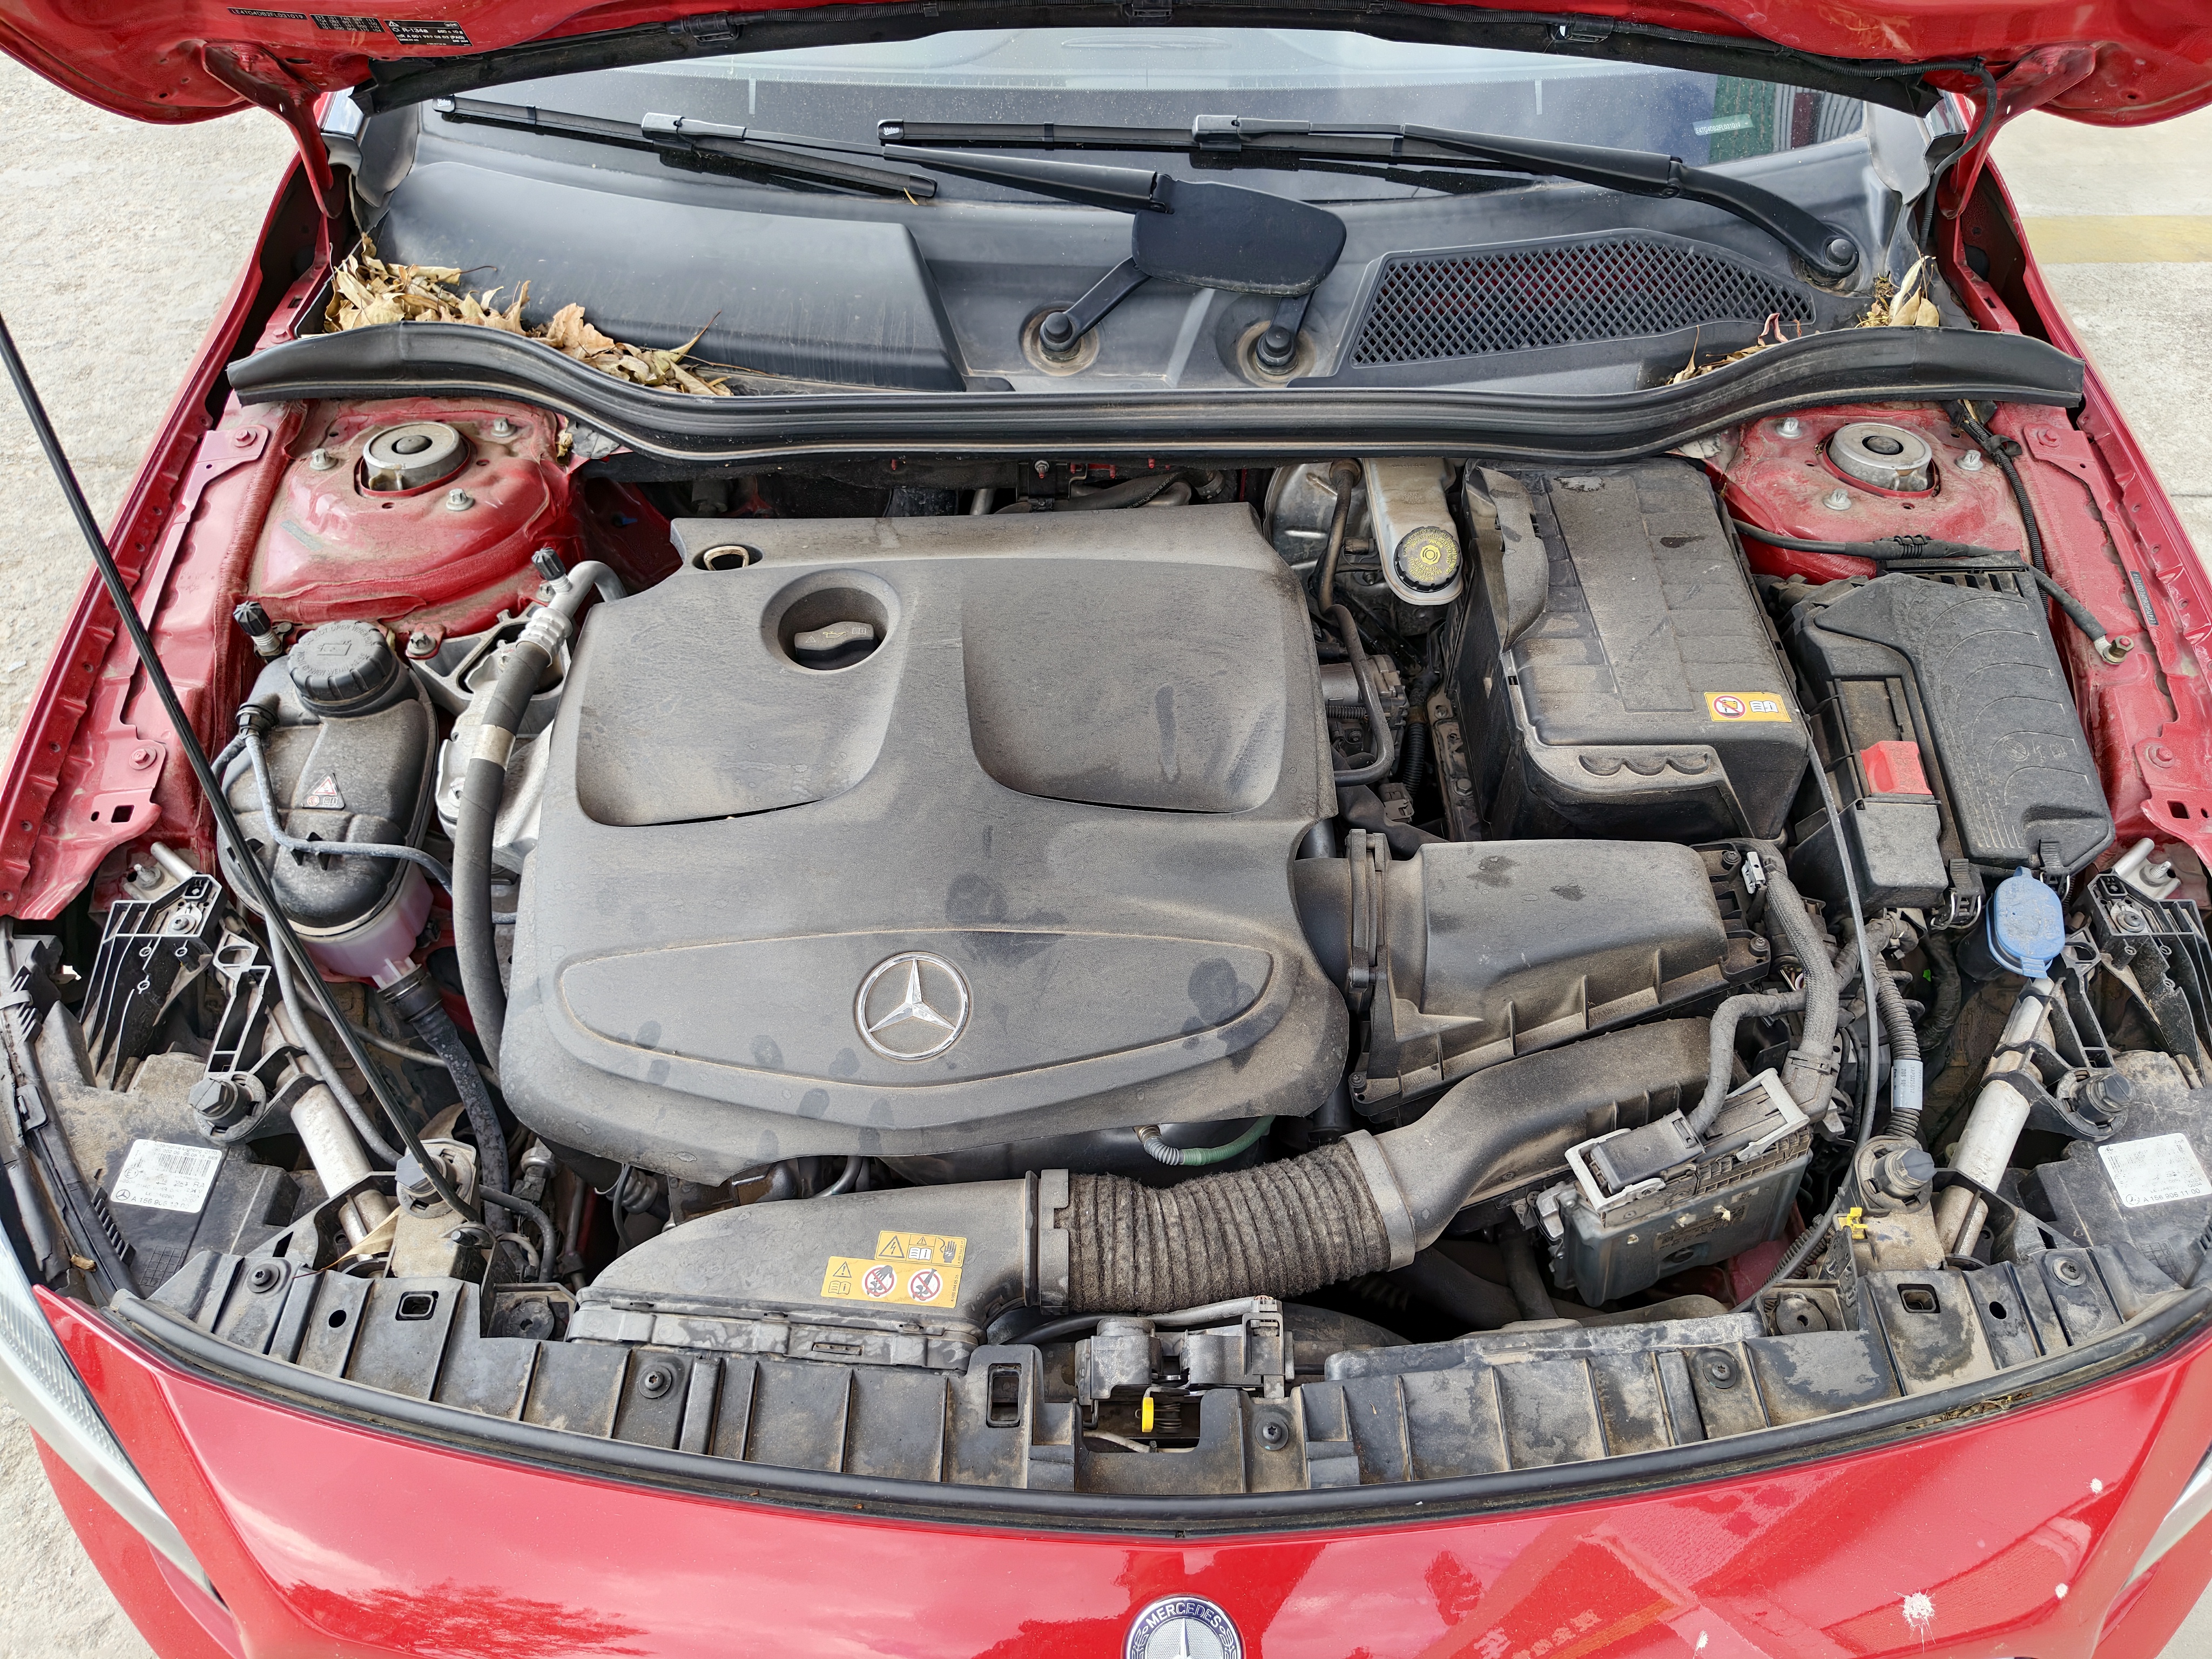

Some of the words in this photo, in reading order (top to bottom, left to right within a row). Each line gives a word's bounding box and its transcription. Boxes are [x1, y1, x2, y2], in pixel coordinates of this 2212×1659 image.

[1428, 538, 1444, 548] WARNING
[1444, 541, 1452, 553] FILLER
[2133, 574, 2156, 624] LE4TG4DB2FL031019
[352, 625, 369, 637] WHEN
[1145, 1602, 1222, 1629] MERCEDES
